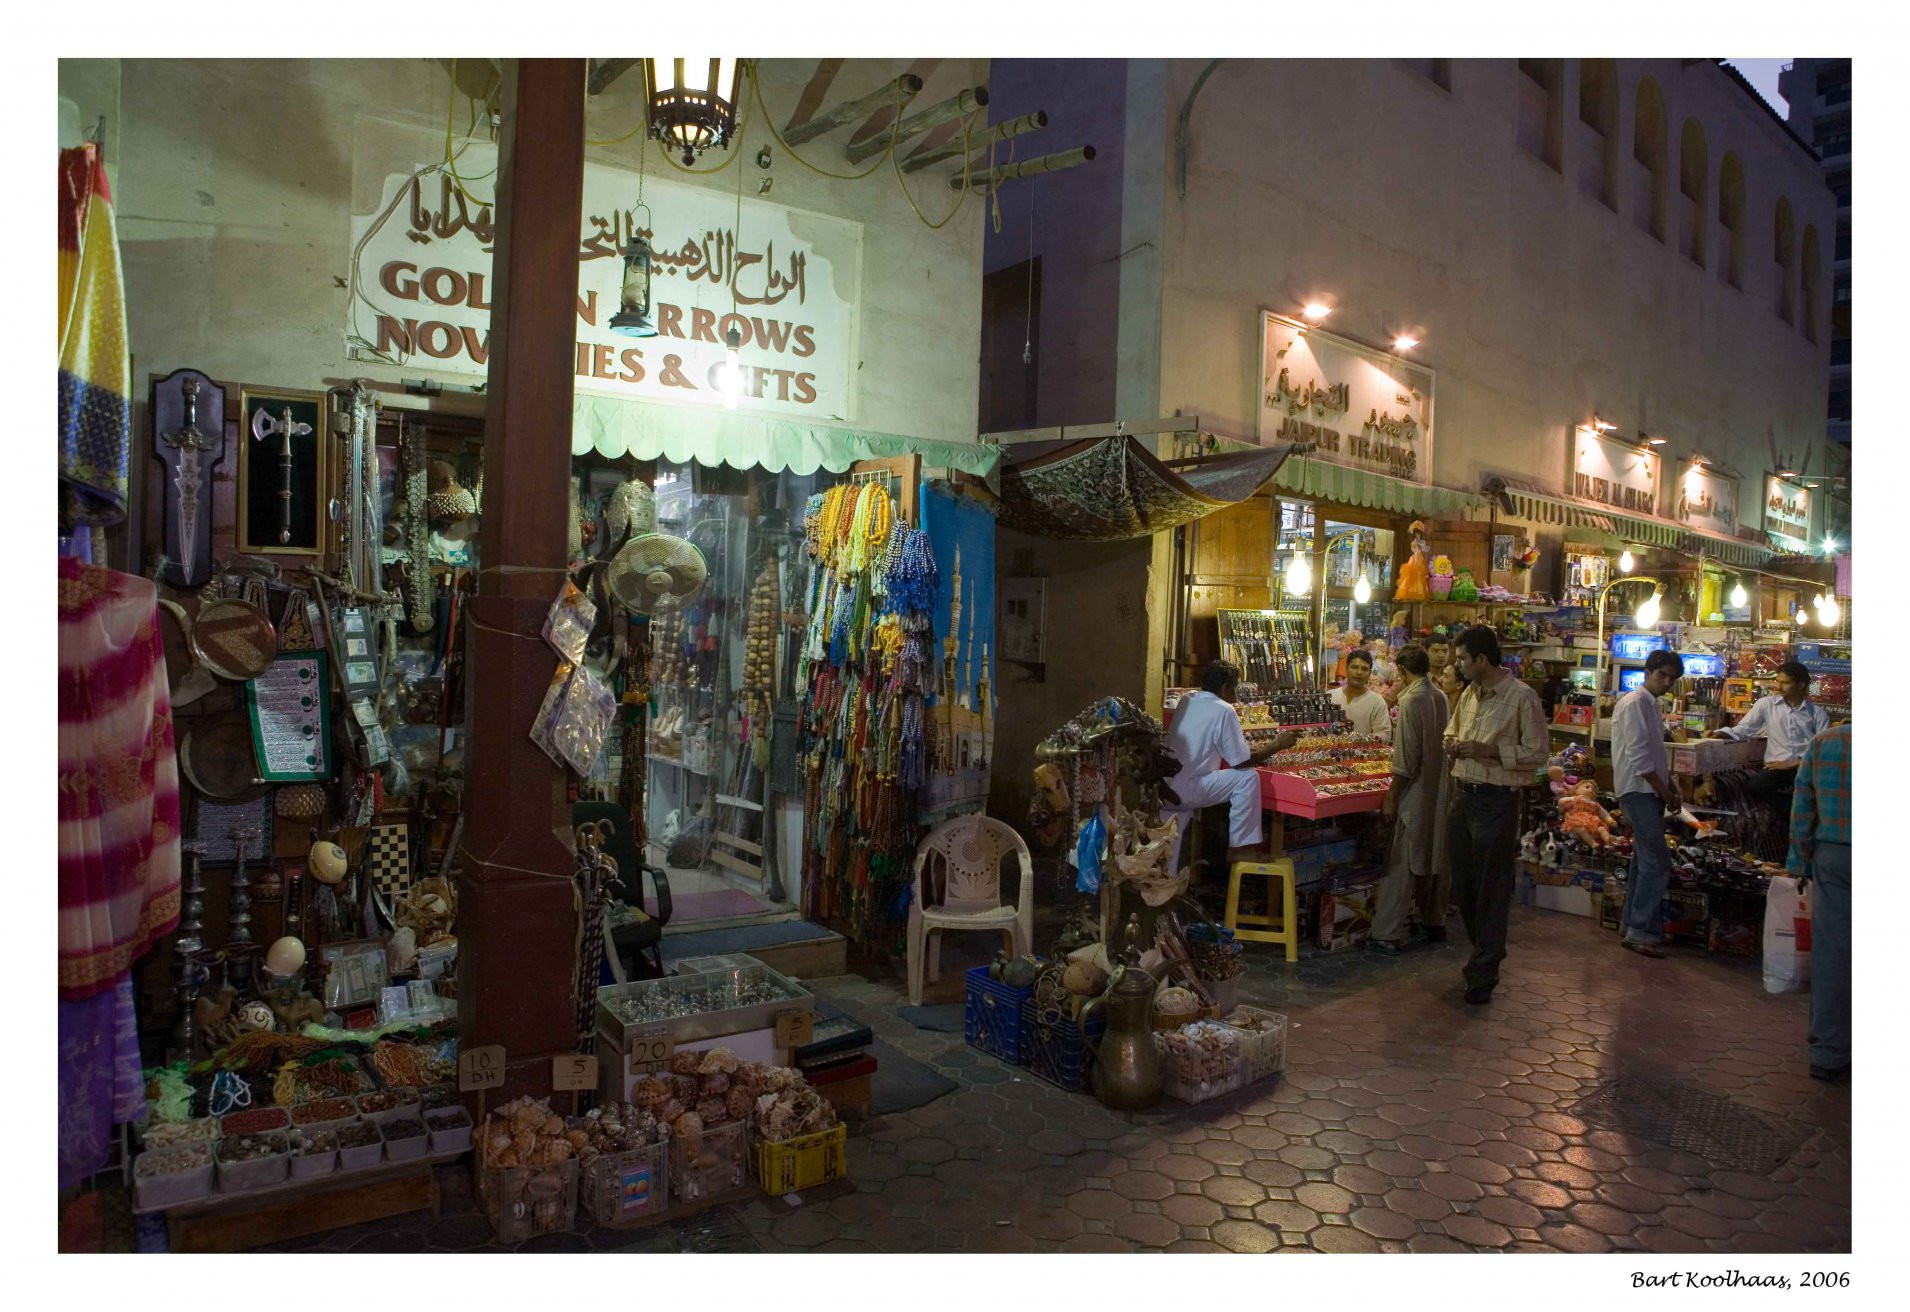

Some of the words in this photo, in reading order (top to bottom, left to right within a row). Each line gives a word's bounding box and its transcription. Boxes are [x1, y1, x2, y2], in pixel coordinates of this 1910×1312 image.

[733, 239, 807, 306] الرماح
[379, 260, 597, 326] GOLN
[654, 302, 817, 358] RROWS
[375, 315, 647, 384] NOVIES
[658, 354, 699, 390] &
[1277, 417, 1341, 452] JAIPUR
[1348, 434, 1417, 471] TRADING
[792, 1017, 804, 1030] 5
[470, 1052, 491, 1070] 10
[635, 1041, 666, 1065] 20
[472, 1070, 495, 1083] DH
[572, 1060, 587, 1074] 5
